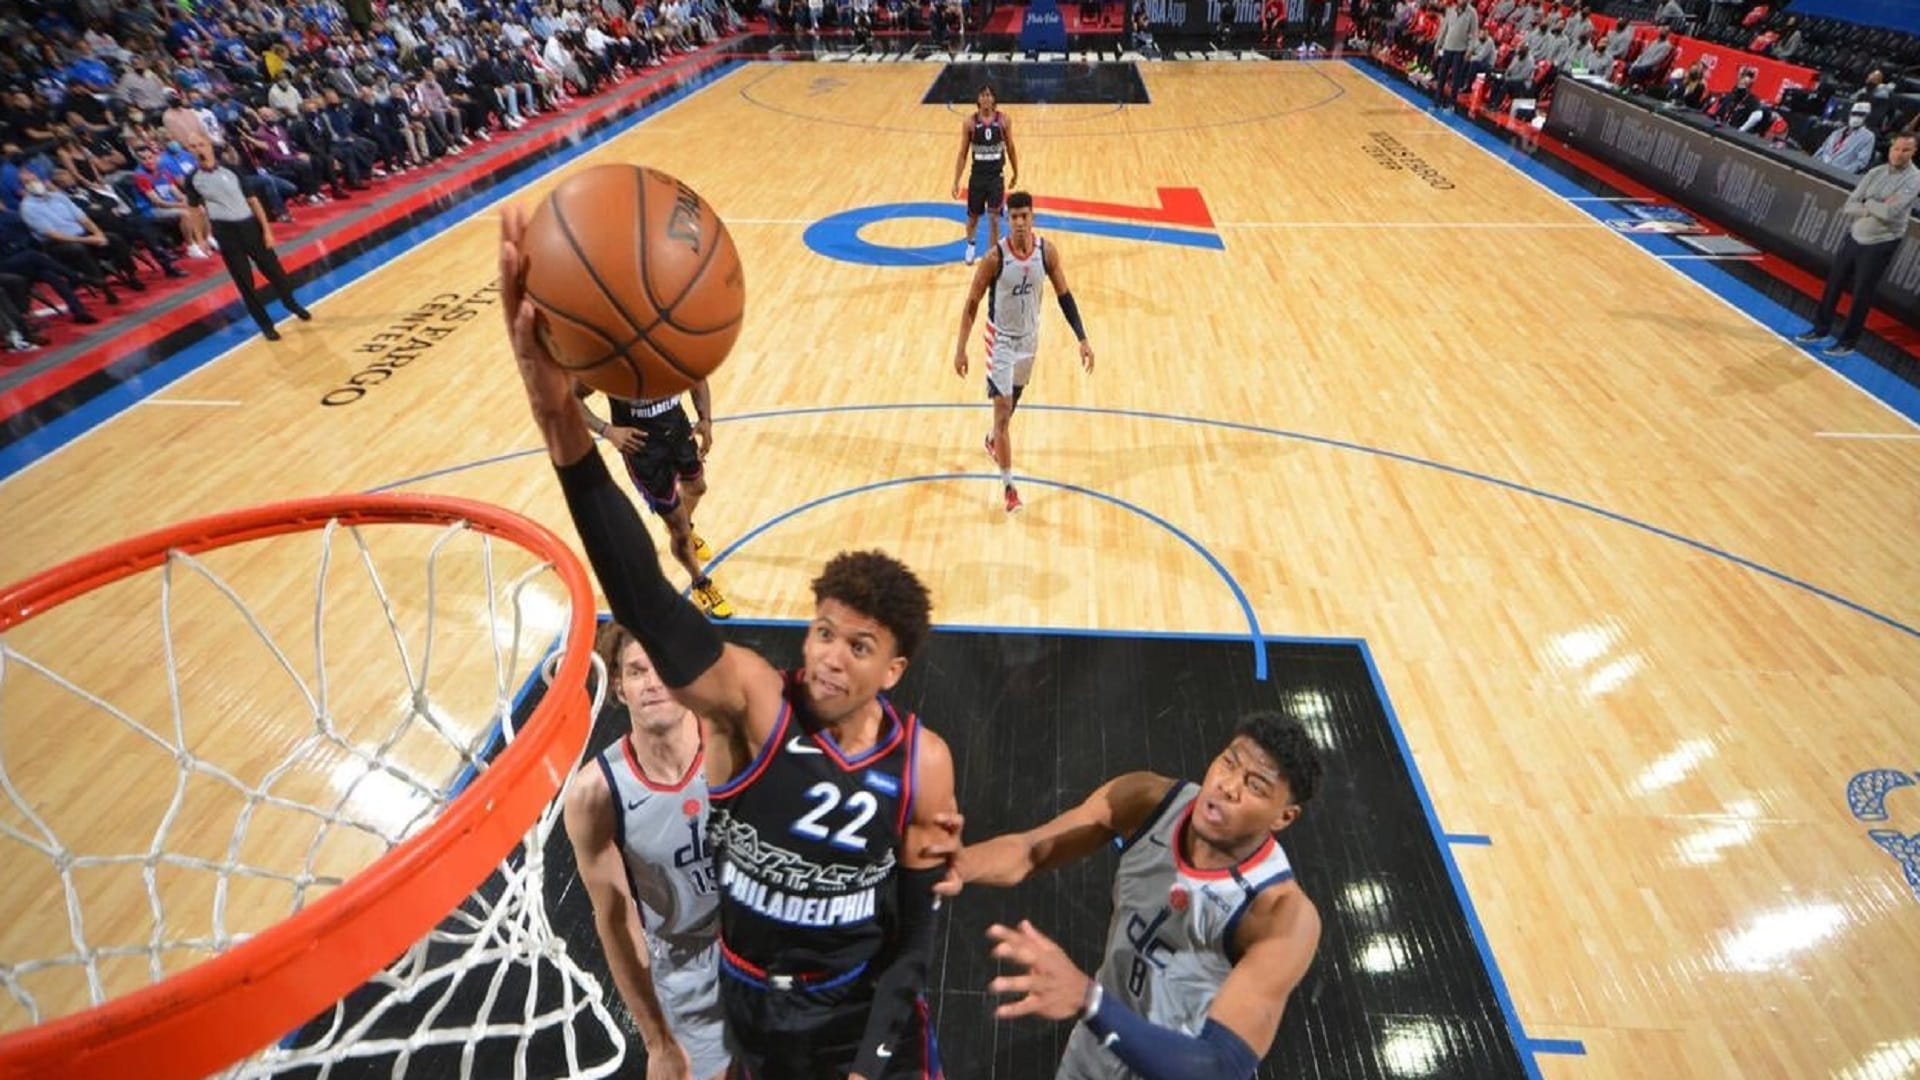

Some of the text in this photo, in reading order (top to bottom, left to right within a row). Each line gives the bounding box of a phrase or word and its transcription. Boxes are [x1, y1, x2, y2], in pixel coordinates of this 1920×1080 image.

[985, 128, 992, 140] 0
[352, 293, 460, 353] CENTER
[320, 326, 459, 406] FARGO
[792, 781, 878, 850] 22
[721, 859, 875, 927] PHILADELPHIA
